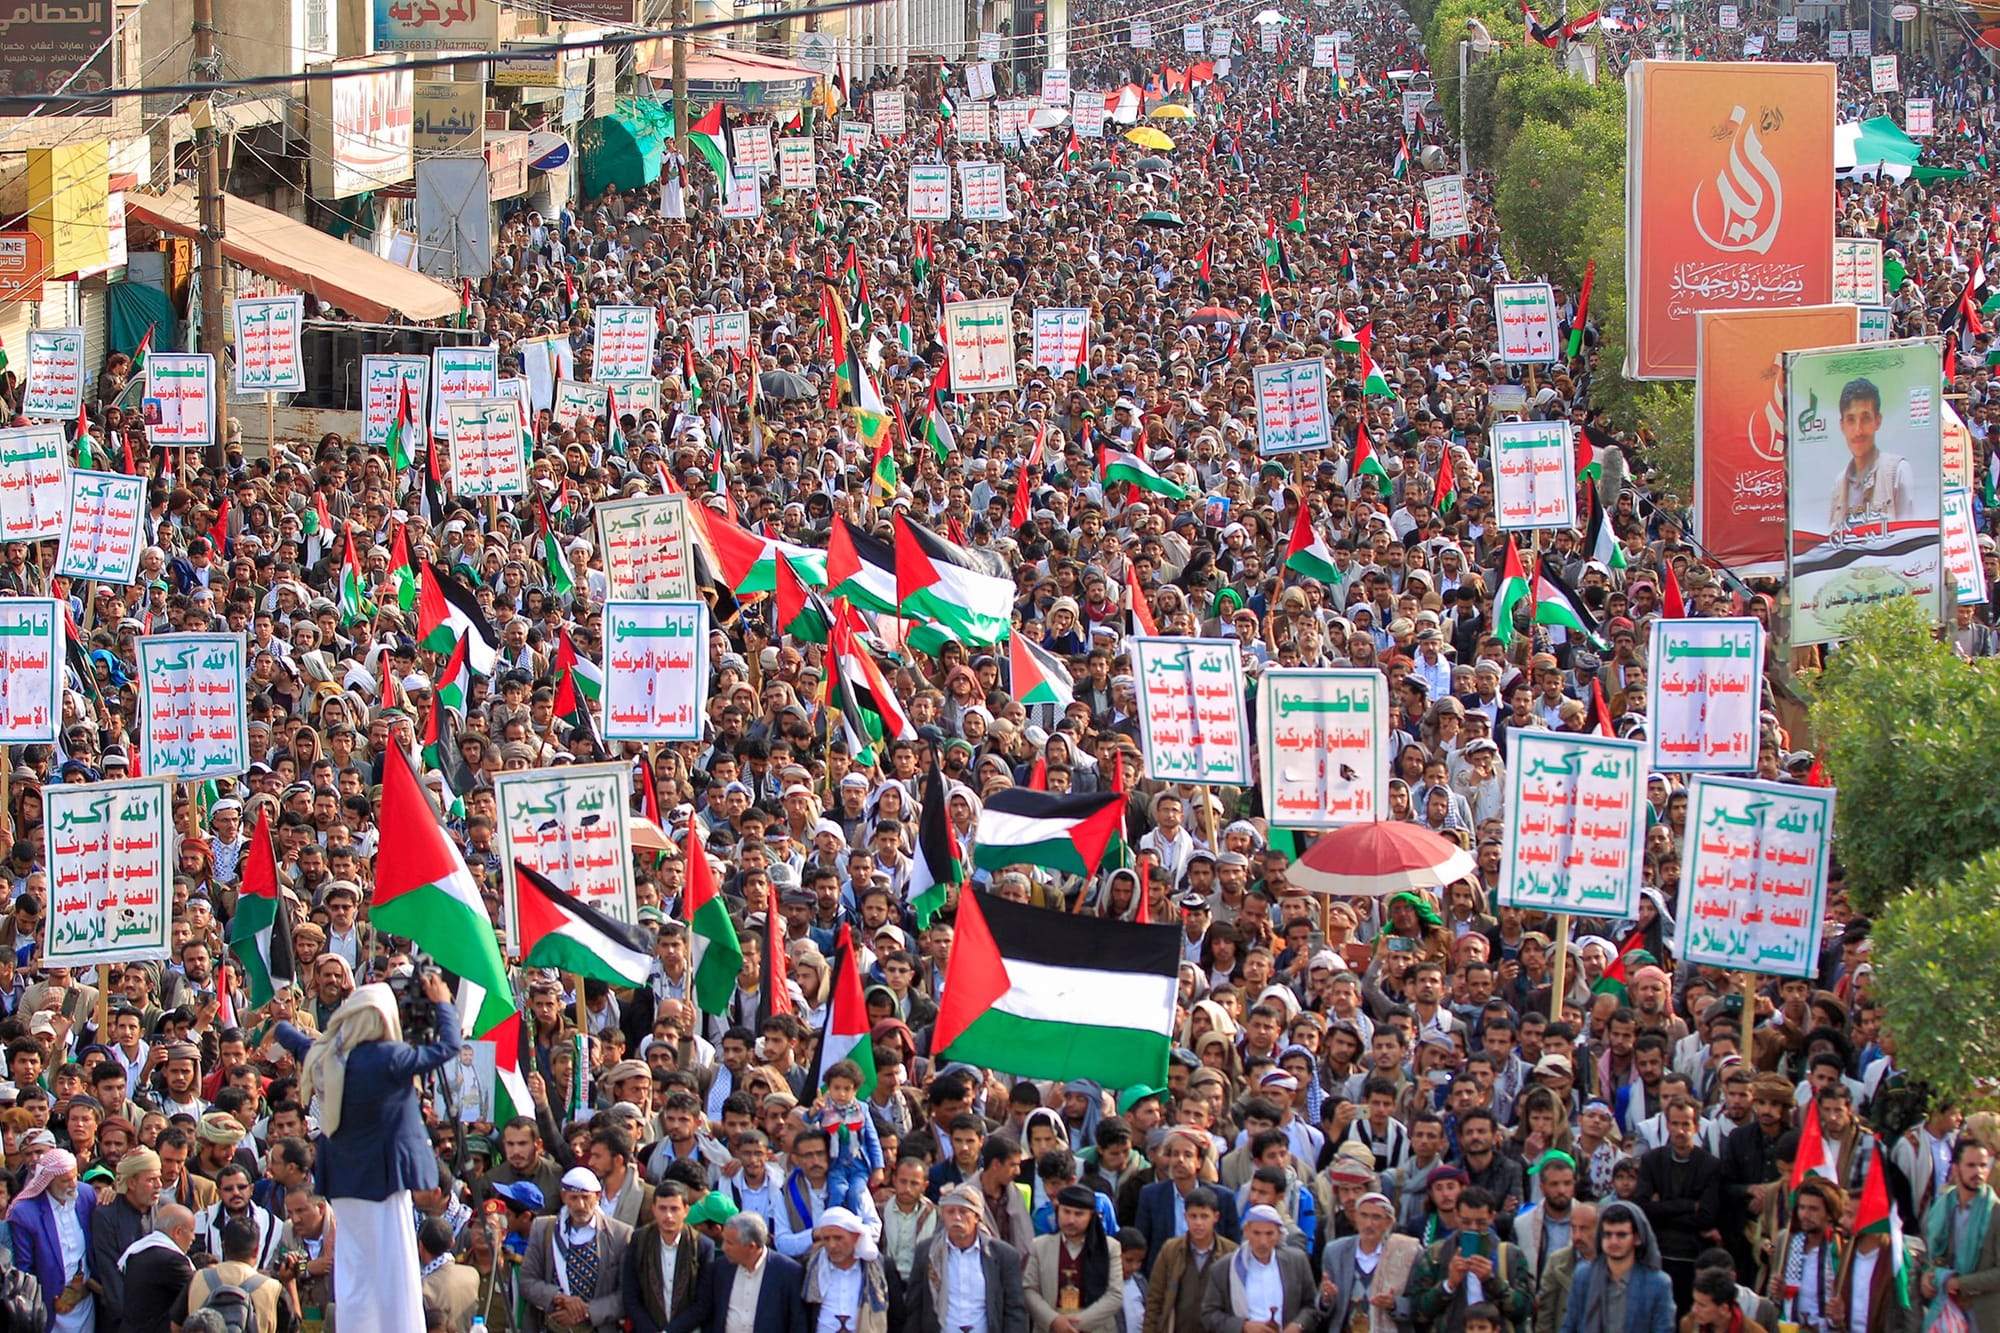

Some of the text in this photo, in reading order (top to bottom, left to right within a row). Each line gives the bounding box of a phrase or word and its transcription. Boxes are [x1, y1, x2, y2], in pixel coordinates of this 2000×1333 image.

[0, 3, 101, 35] الحطامي
[385, 40, 488, 51] 01-316813 Pharmacy
[1499, 433, 1562, 453] قاطعوا
[1533, 459, 1562, 476] البضائع
[1529, 480, 1534, 494] و
[7, 510, 62, 533] لإسرائيلية
[654, 506, 680, 525] الله
[650, 530, 680, 546] الموت
[0, 613, 48, 636] قاط
[612, 614, 694, 643] قاطعوا
[10, 650, 47, 673] البضائع
[151, 646, 234, 677] الله أكبر
[612, 650, 693, 673] البضائع الأمريكية
[1663, 634, 1752, 664] قاطعوا
[1199, 652, 1231, 674] الله
[152, 679, 234, 697] الموت لأمريكا
[647, 677, 654, 696] و
[1196, 684, 1232, 700] الموت
[1661, 672, 1749, 697] البضائع الأمريكية
[152, 701, 235, 721] الموت لإسرائيل
[611, 704, 692, 727] الإسرائيلية
[1198, 708, 1235, 724] الموت
[1274, 688, 1370, 719] قاطعوا
[1700, 703, 1707, 723] و
[152, 725, 236, 744] اللعنة على اليهود
[1153, 729, 1237, 748] اللعنة على اليهود
[1275, 727, 1370, 753] البضائع الأمريكية
[1660, 731, 1748, 757] الإسرائيلية
[153, 746, 238, 771] النصر للإسلام
[1156, 743, 1239, 776] النصر للإسلام
[1318, 759, 1325, 779] و
[1526, 747, 1633, 781] الله أكبر
[512, 784, 615, 823] الله أكبر
[1277, 788, 1371, 816] الإسرائيلية
[1522, 781, 1629, 812] الموت لأمريكا
[54, 793, 160, 830] الله أكبر
[1706, 798, 1822, 835] الله أكبر
[571, 816, 616, 843] الموت
[1520, 814, 1628, 841] الموت لإسرائيل
[55, 829, 158, 857] الموت لأمريكا
[1700, 831, 1814, 866] الموت لأمريكا
[573, 850, 619, 871] الموت
[1518, 845, 1626, 869] اللعنة على اليهود
[56, 860, 158, 888] الموت لإسرائيل
[1517, 861, 1623, 904] النصر للإسلام
[1697, 866, 1811, 898] الموت لإسرائيل
[587, 878, 621, 896] اللعنة
[56, 886, 158, 917] اللعنة على اليهود
[1694, 898, 1808, 927] اللعنة على اليهود
[55, 908, 157, 943] النصر للإسلام
[1691, 915, 1805, 962] النصر للإسلام
